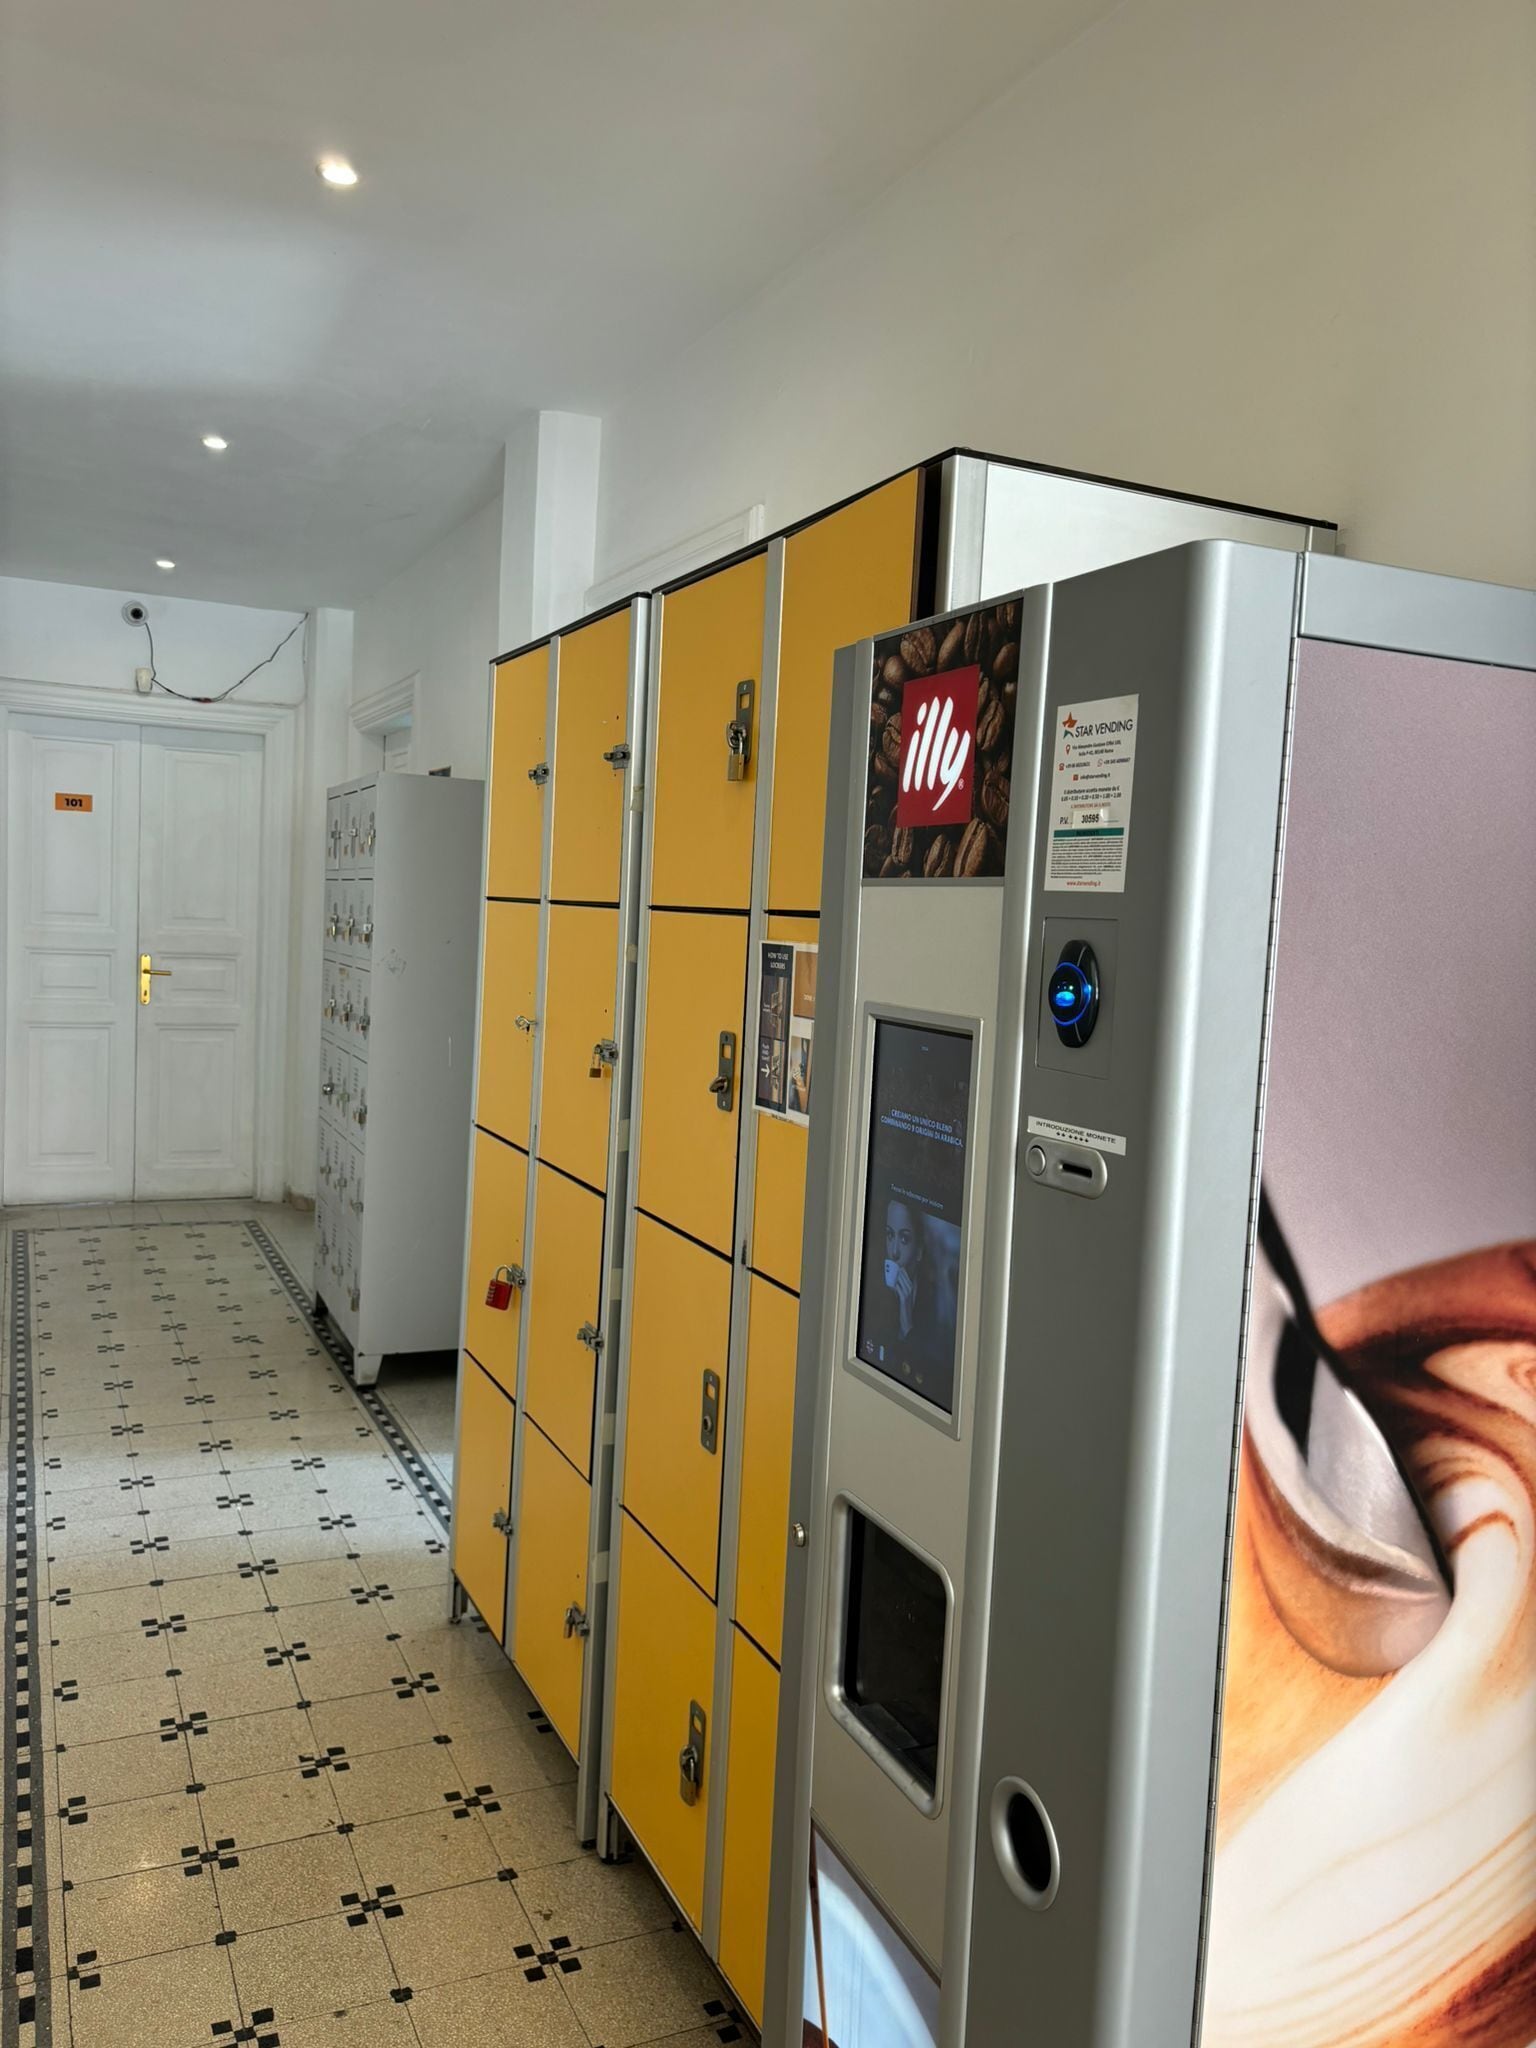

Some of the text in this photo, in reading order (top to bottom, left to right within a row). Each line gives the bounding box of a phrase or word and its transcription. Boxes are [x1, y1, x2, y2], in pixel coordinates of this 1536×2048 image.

[1075, 718, 1134, 738] STAR VENDING
[902, 696, 971, 811] illy
[65, 798, 82, 807] 101
[1035, 1120, 1116, 1144] INTRODUZIONE MONETE
